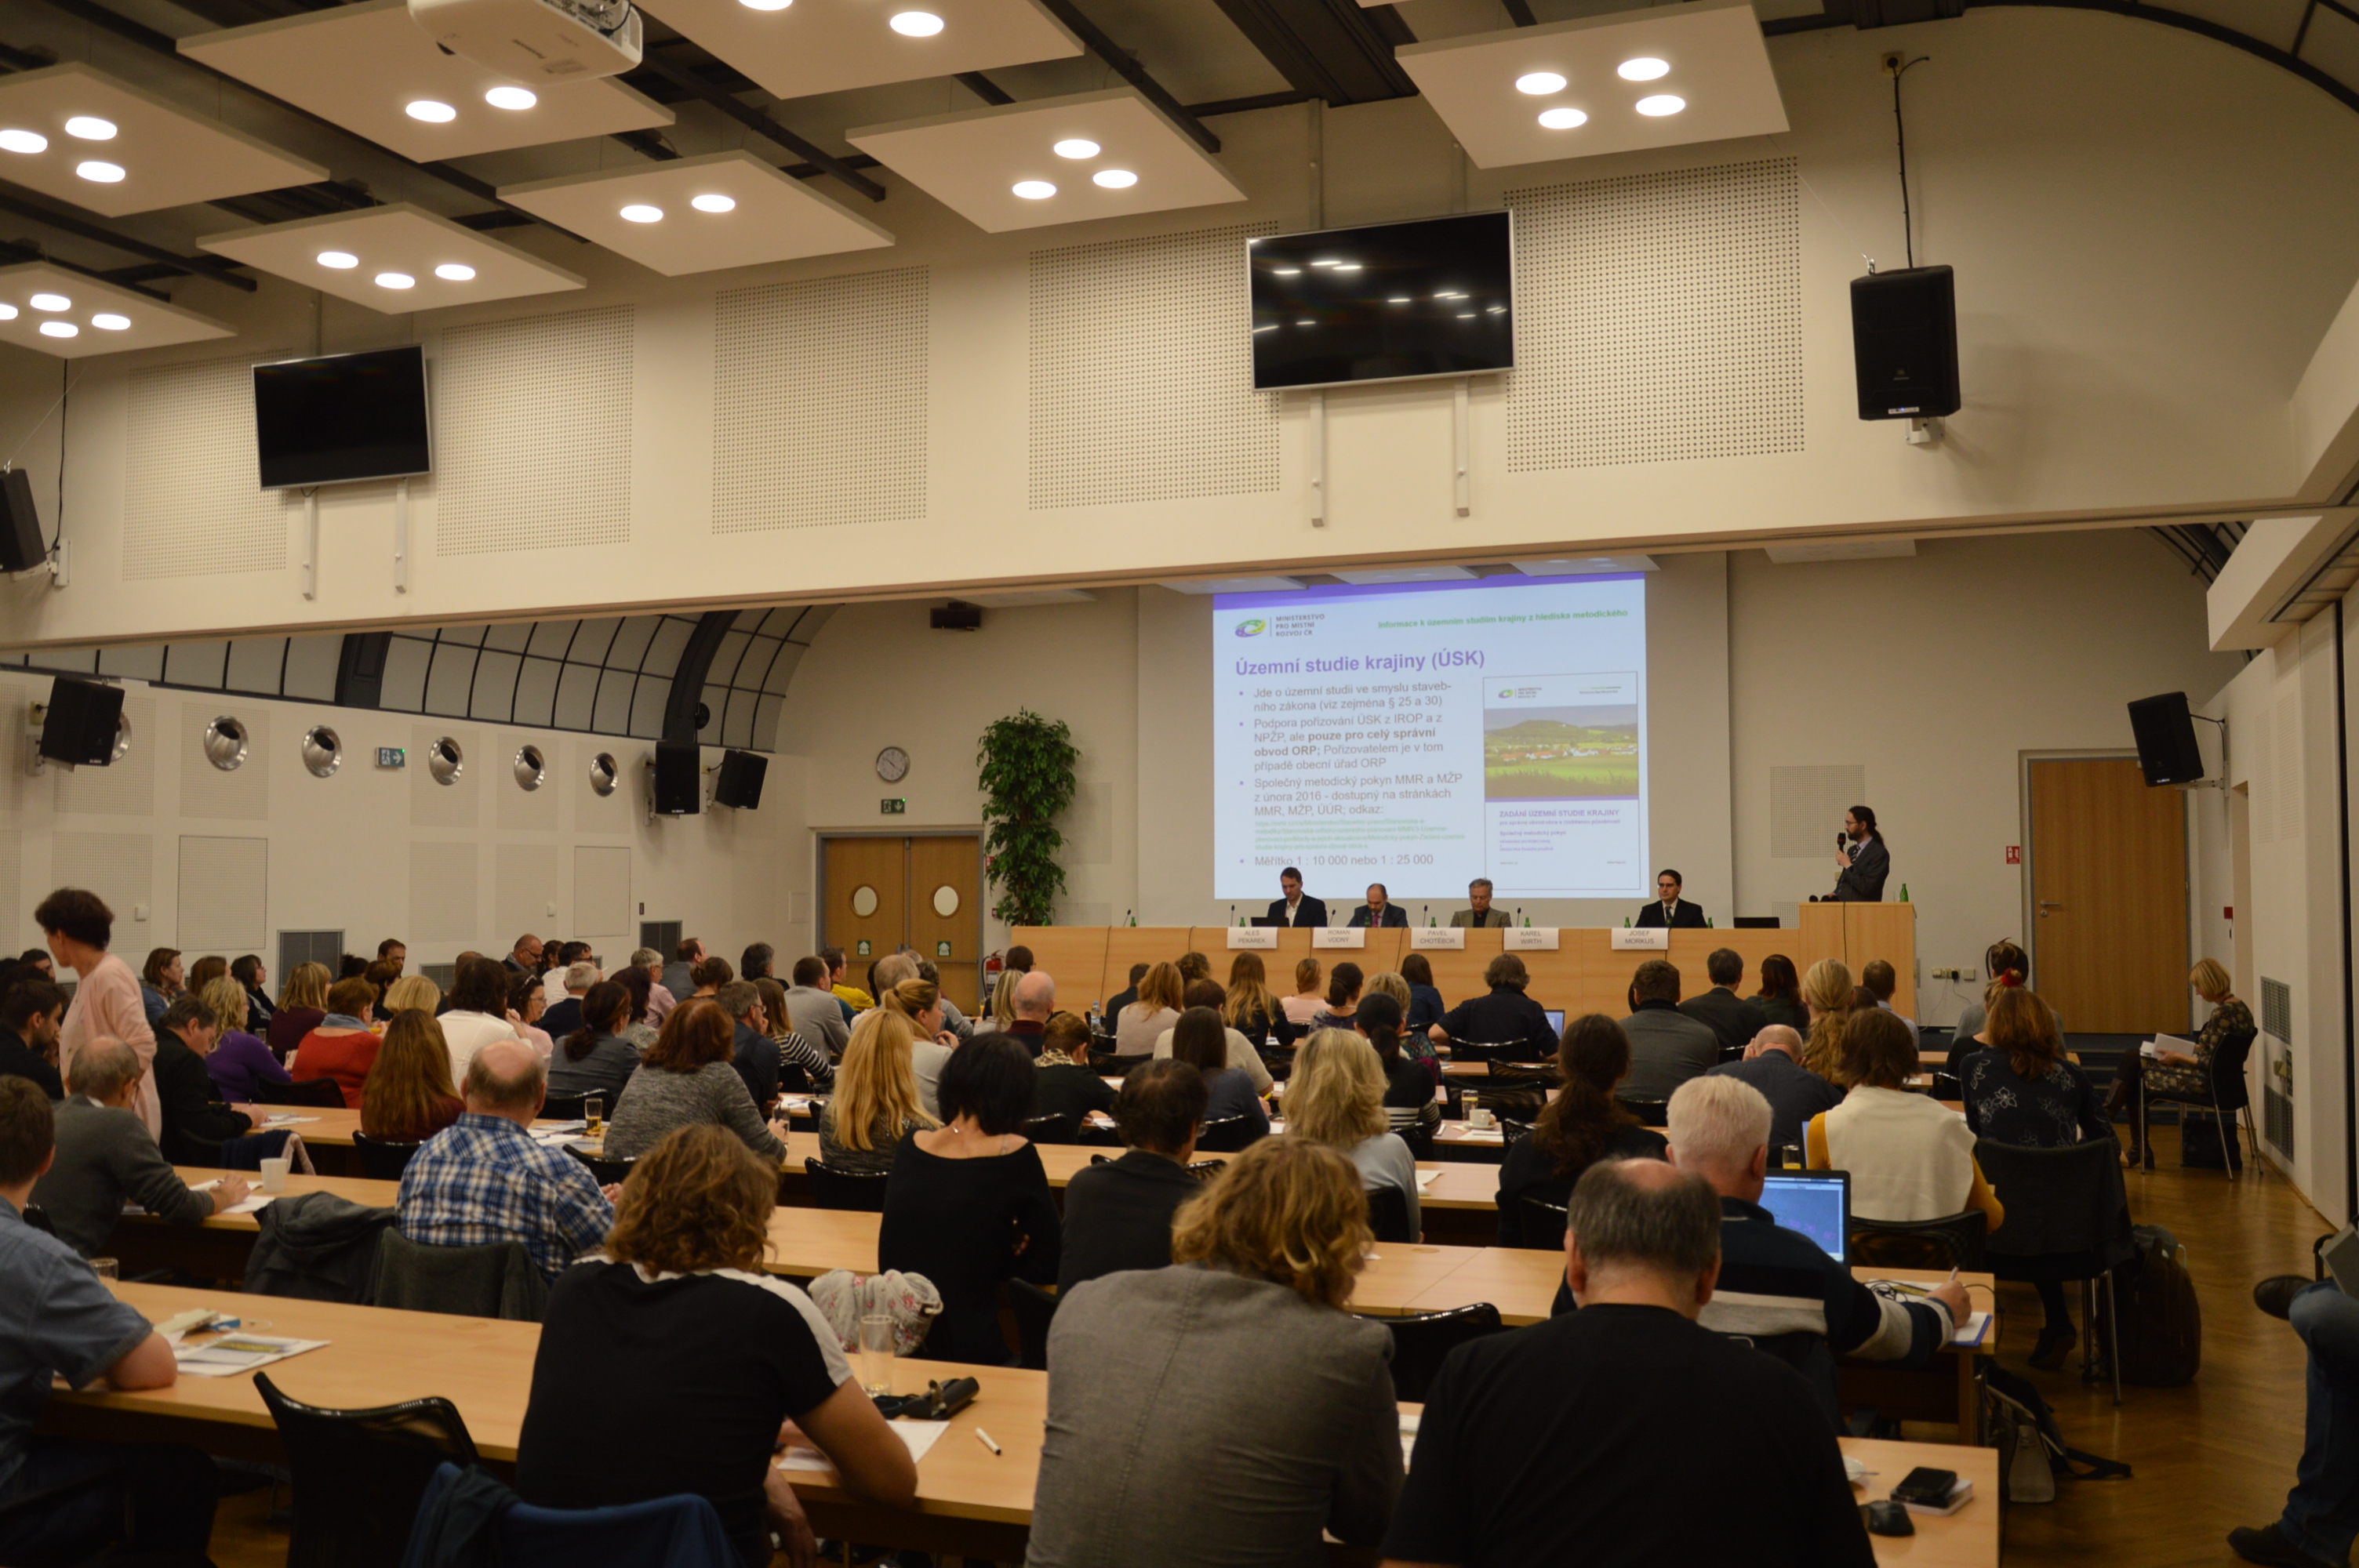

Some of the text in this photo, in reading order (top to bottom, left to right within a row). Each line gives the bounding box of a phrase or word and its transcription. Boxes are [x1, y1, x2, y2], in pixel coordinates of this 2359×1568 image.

[1378, 620, 1418, 629] Informace
[1499, 614, 1527, 625] krajiny
[1536, 612, 1571, 621] hlediska
[1572, 609, 1628, 620] metodického
[1236, 648, 1485, 676] Územní studie krajiny (ÚSK)
[1254, 688, 1273, 699] Jde
[1285, 688, 1323, 697] územní
[1325, 685, 1354, 695] studii
[1372, 683, 1409, 697] smyslu
[1412, 681, 1452, 692] staveb-
[1254, 702, 1277, 713] ního
[1279, 700, 1317, 711] zákona
[1320, 699, 1338, 713] (viz
[1340, 698, 1386, 712] zejména
[1388, 697, 1395, 710] §
[1398, 696, 1412, 707] 25
[1425, 695, 1443, 708] 30)
[1254, 719, 1297, 731] Podpora
[1301, 716, 1354, 730] pořizování
[1358, 713, 1382, 725] ÚSK
[1394, 713, 1423, 724] IROP
[1254, 728, 1436, 744] NPŽP, ale pouze pro celý správní
[1255, 746, 1289, 757] obvod
[1292, 746, 1321, 757] ORP;
[1324, 744, 1398, 755] Pořizovatelem
[1401, 742, 1411, 755] je
[1423, 742, 1444, 752] tom
[1254, 757, 1387, 773] případě obecní úřad ORP
[1255, 778, 1302, 789] Společný
[1305, 776, 1358, 788] metodický
[1361, 775, 1392, 787] pokyn
[1395, 775, 1424, 785] MMR
[1437, 772, 1463, 783] MŽP
[1263, 792, 1293, 802] února
[1296, 791, 1321, 801] 2016
[1332, 790, 1380, 803] dostupný
[1399, 789, 1451, 800] stránkách
[1255, 804, 1384, 818] MMR, MŽP, ÚÚR; odkaz:
[1528, 809, 1557, 818] ÚZEMNÍ
[1255, 855, 1293, 866] Měřítko
[1296, 856, 1302, 866] 1
[1313, 856, 1325, 866] 10
[1328, 855, 1348, 866] 000
[1350, 855, 1377, 865] nebo
[1381, 855, 1387, 865] 1
[1397, 855, 1410, 865] 25
[1413, 855, 1434, 865] 000
